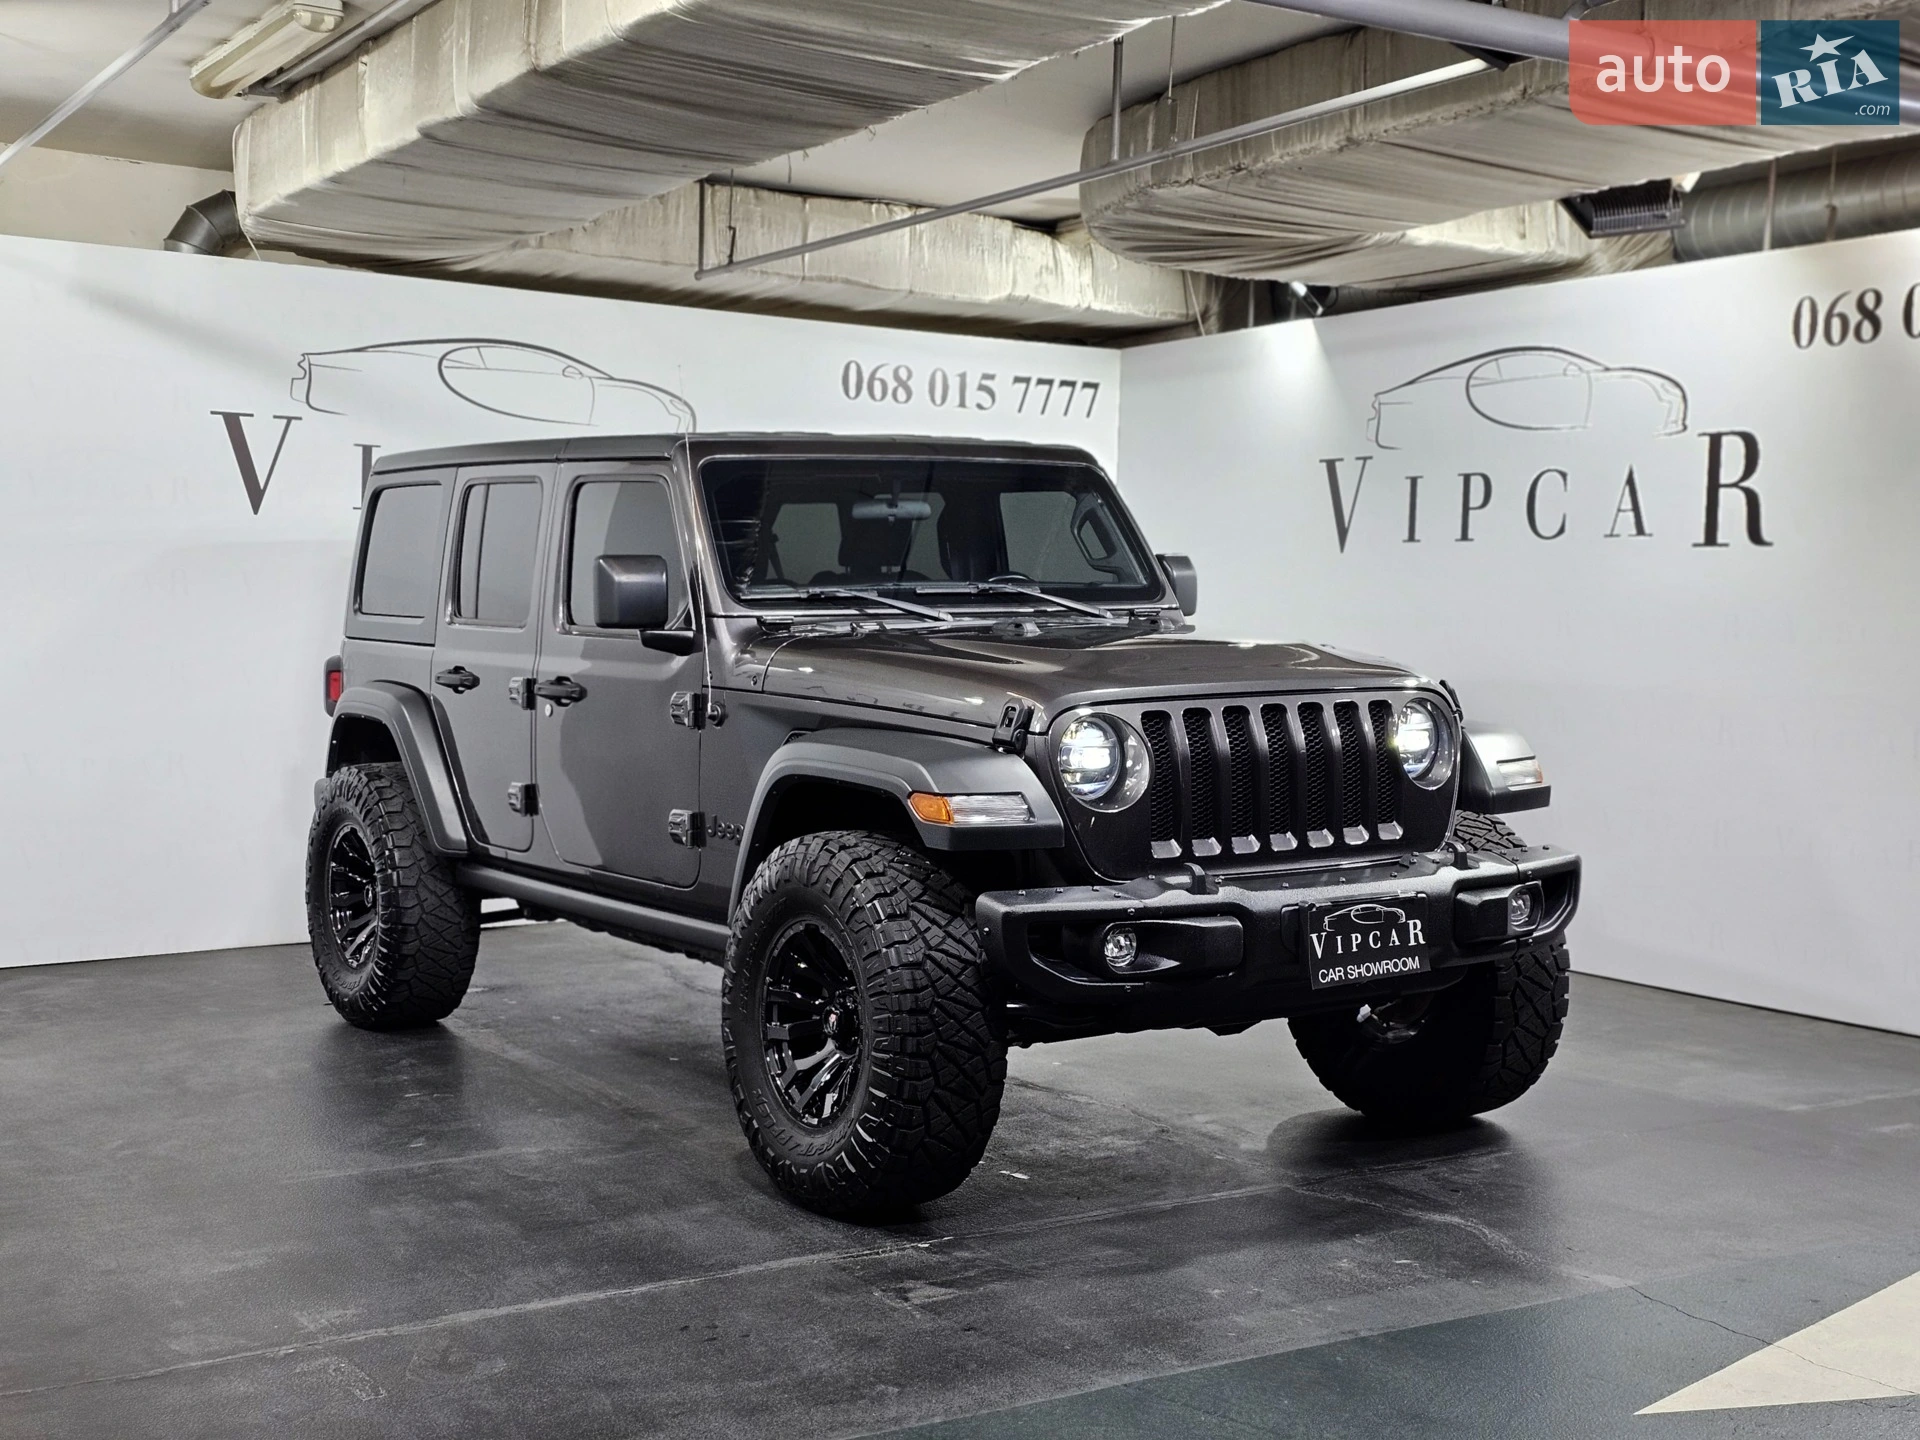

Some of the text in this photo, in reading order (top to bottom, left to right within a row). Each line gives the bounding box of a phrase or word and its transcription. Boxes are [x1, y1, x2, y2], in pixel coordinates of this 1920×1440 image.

[1792, 288, 1883, 350] 068
[841, 360, 1101, 418] 068 015 7777
[706, 814, 744, 846] Jeep
[1318, 956, 1421, 983] CAR SHOWROOM
